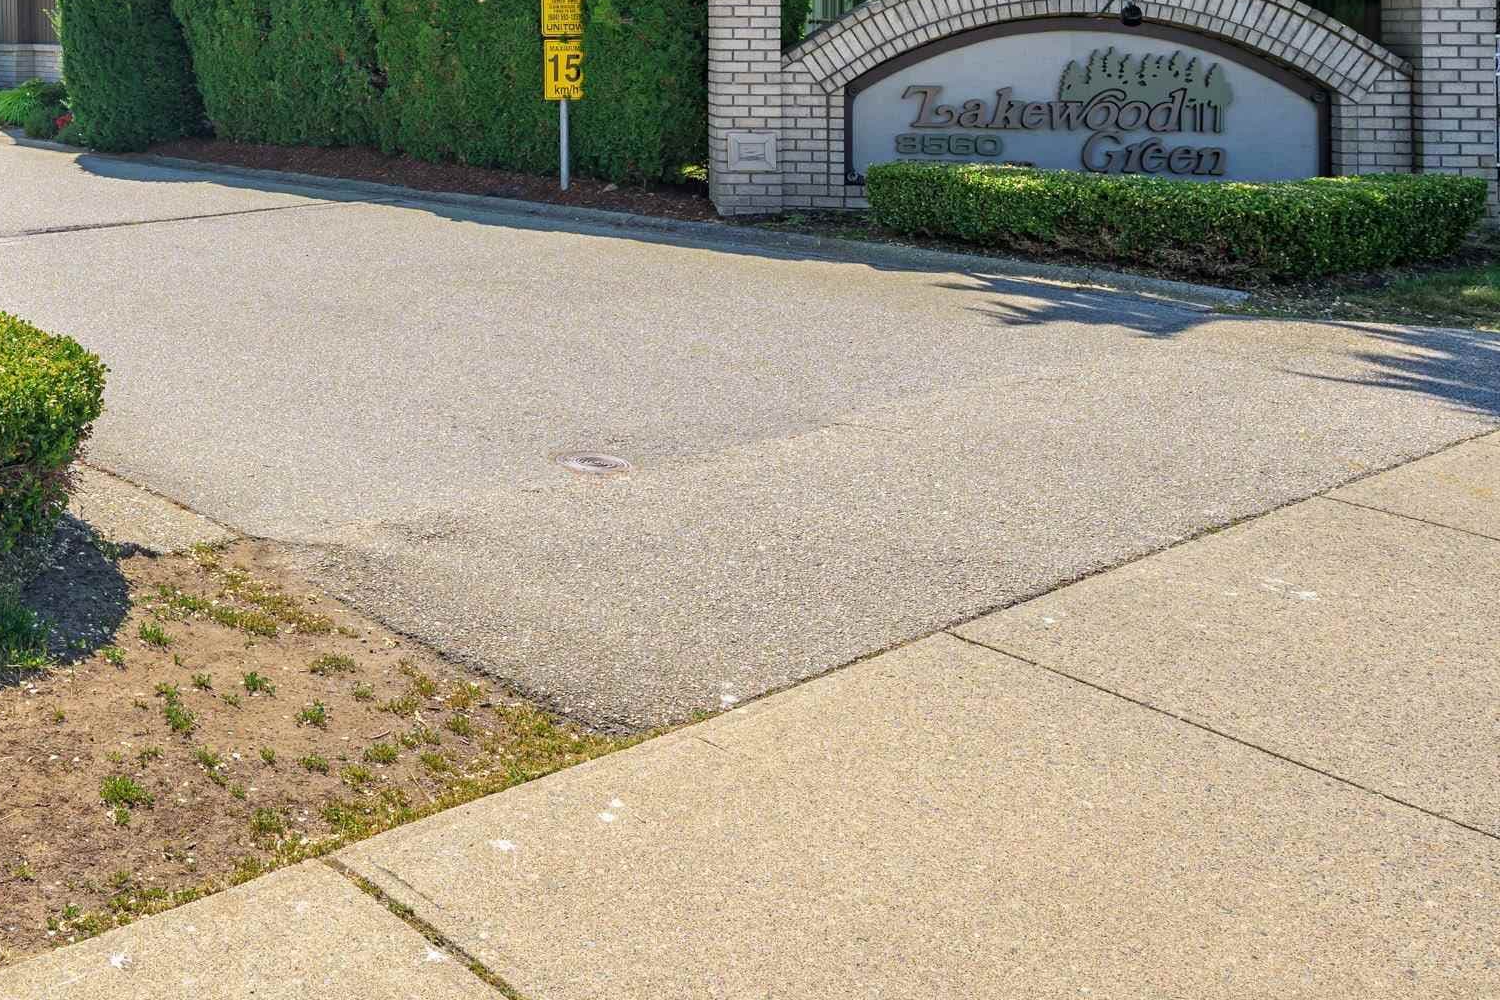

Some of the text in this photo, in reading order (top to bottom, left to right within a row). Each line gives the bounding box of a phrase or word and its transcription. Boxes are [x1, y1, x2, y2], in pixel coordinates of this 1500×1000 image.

[548, 54, 581, 83] 15
[554, 84, 579, 95] km/h
[902, 86, 1188, 132] Lakewood
[895, 133, 1003, 157] 8560
[1081, 130, 1227, 176] Green
